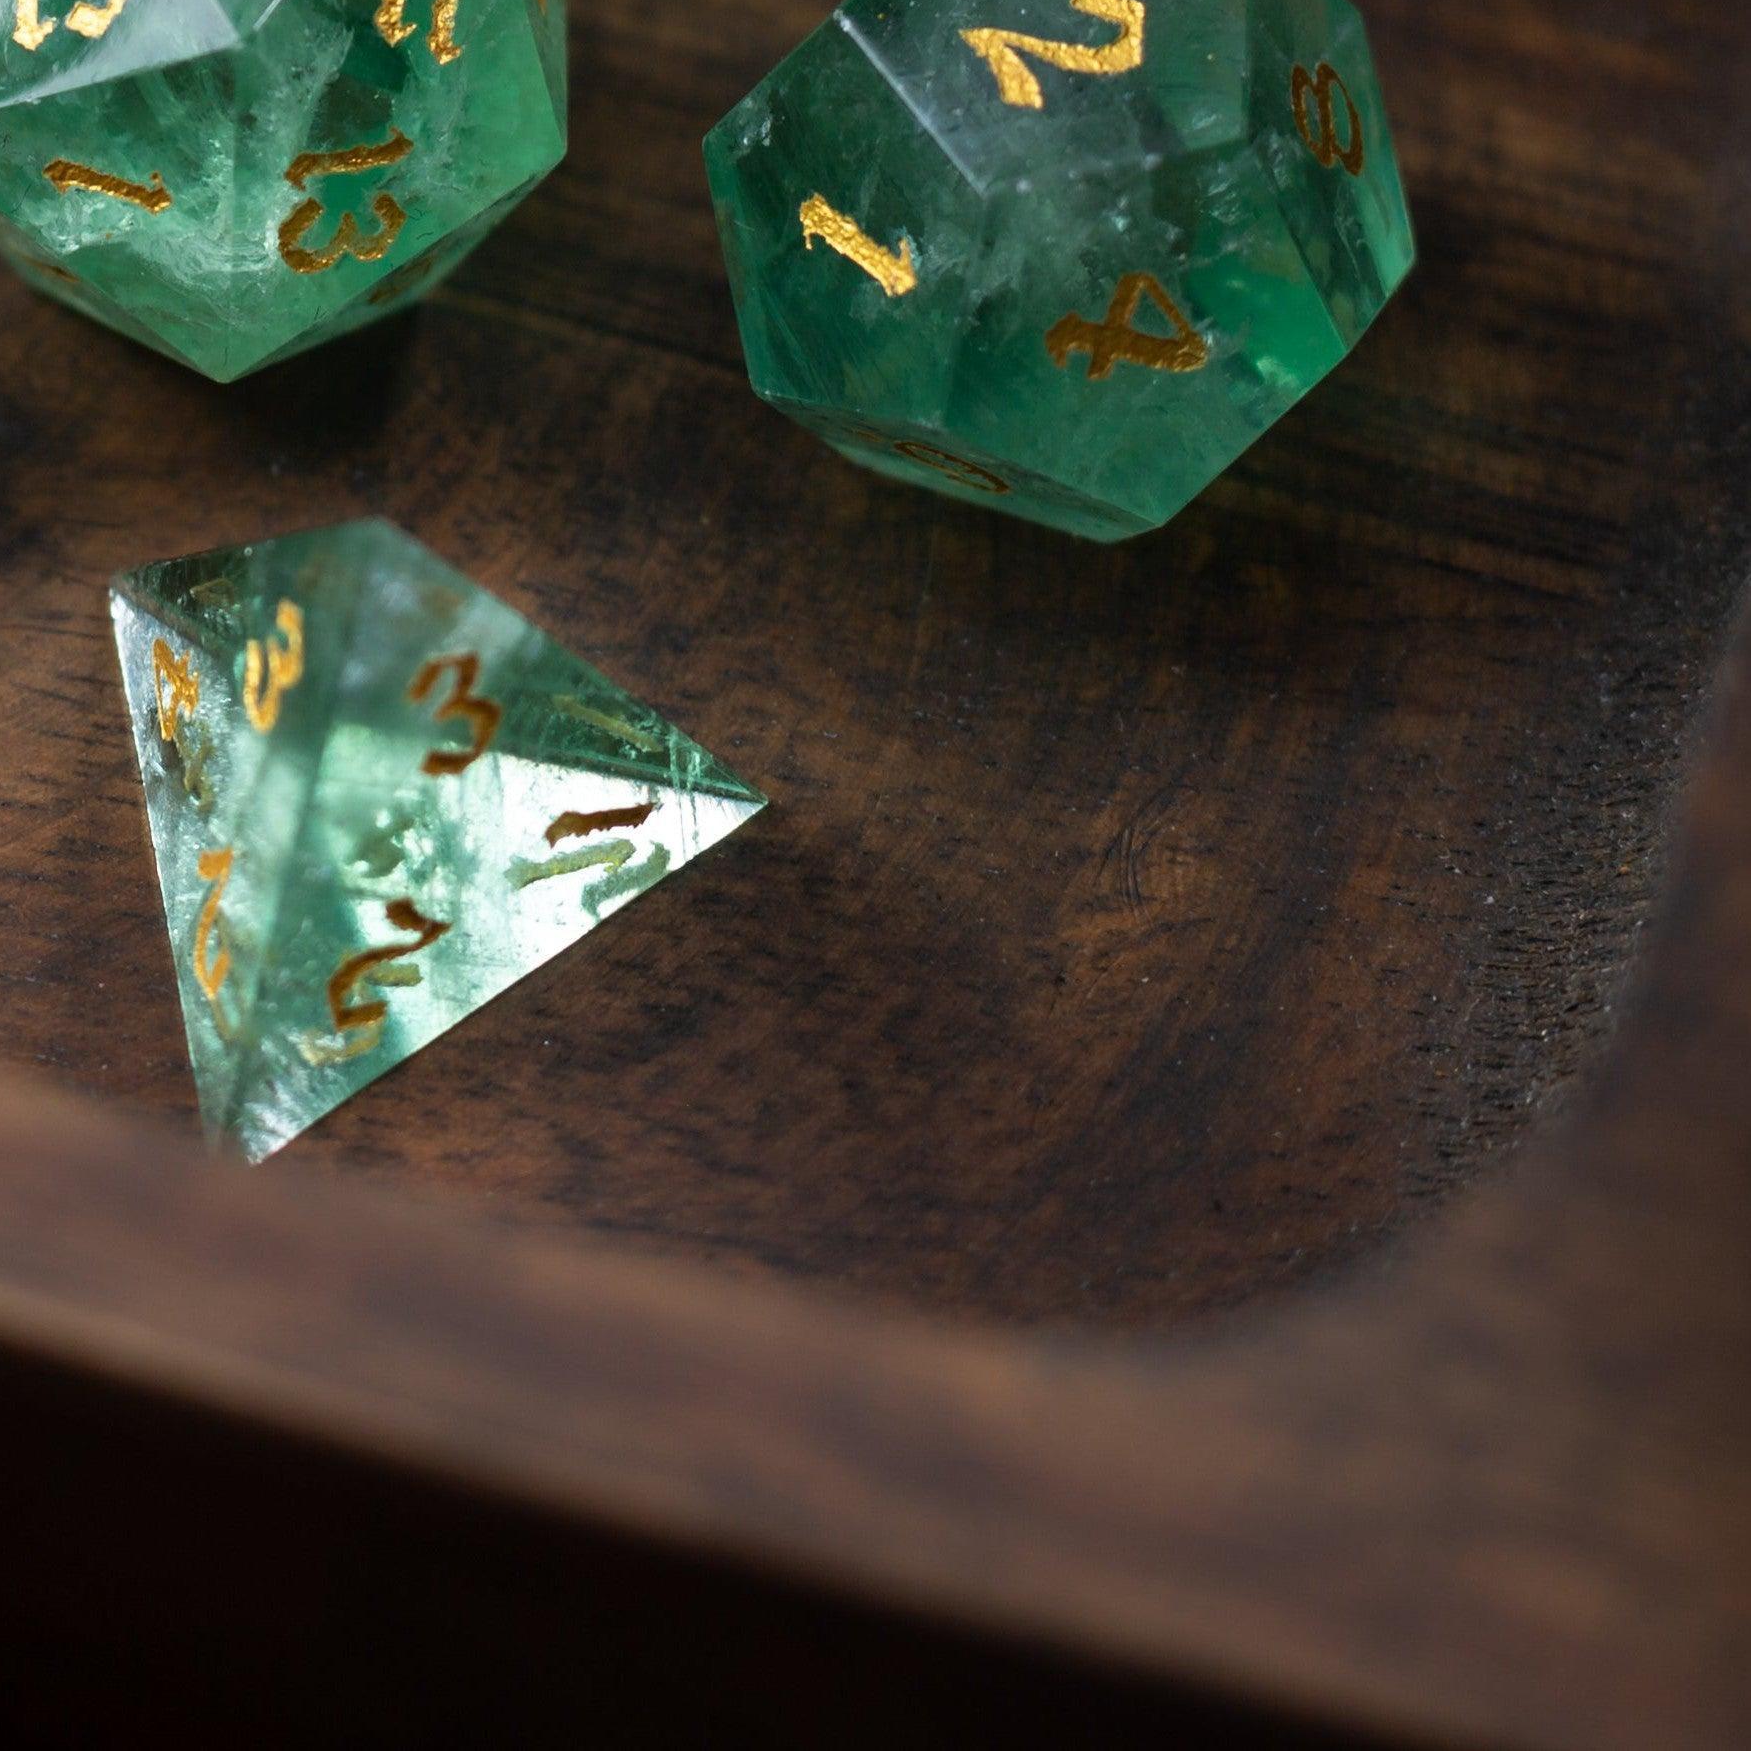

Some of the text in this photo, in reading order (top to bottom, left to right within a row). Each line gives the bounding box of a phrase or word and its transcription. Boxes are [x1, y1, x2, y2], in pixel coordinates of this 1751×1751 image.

[1291, 61, 1364, 177] 8
[43, 158, 174, 215] 1
[276, 128, 414, 274] 13
[799, 192, 918, 297] 1
[1043, 271, 1210, 380] 4
[244, 597, 306, 735] 3
[406, 652, 503, 776] 3
[193, 846, 234, 1000] 2
[325, 896, 452, 1032] 2
